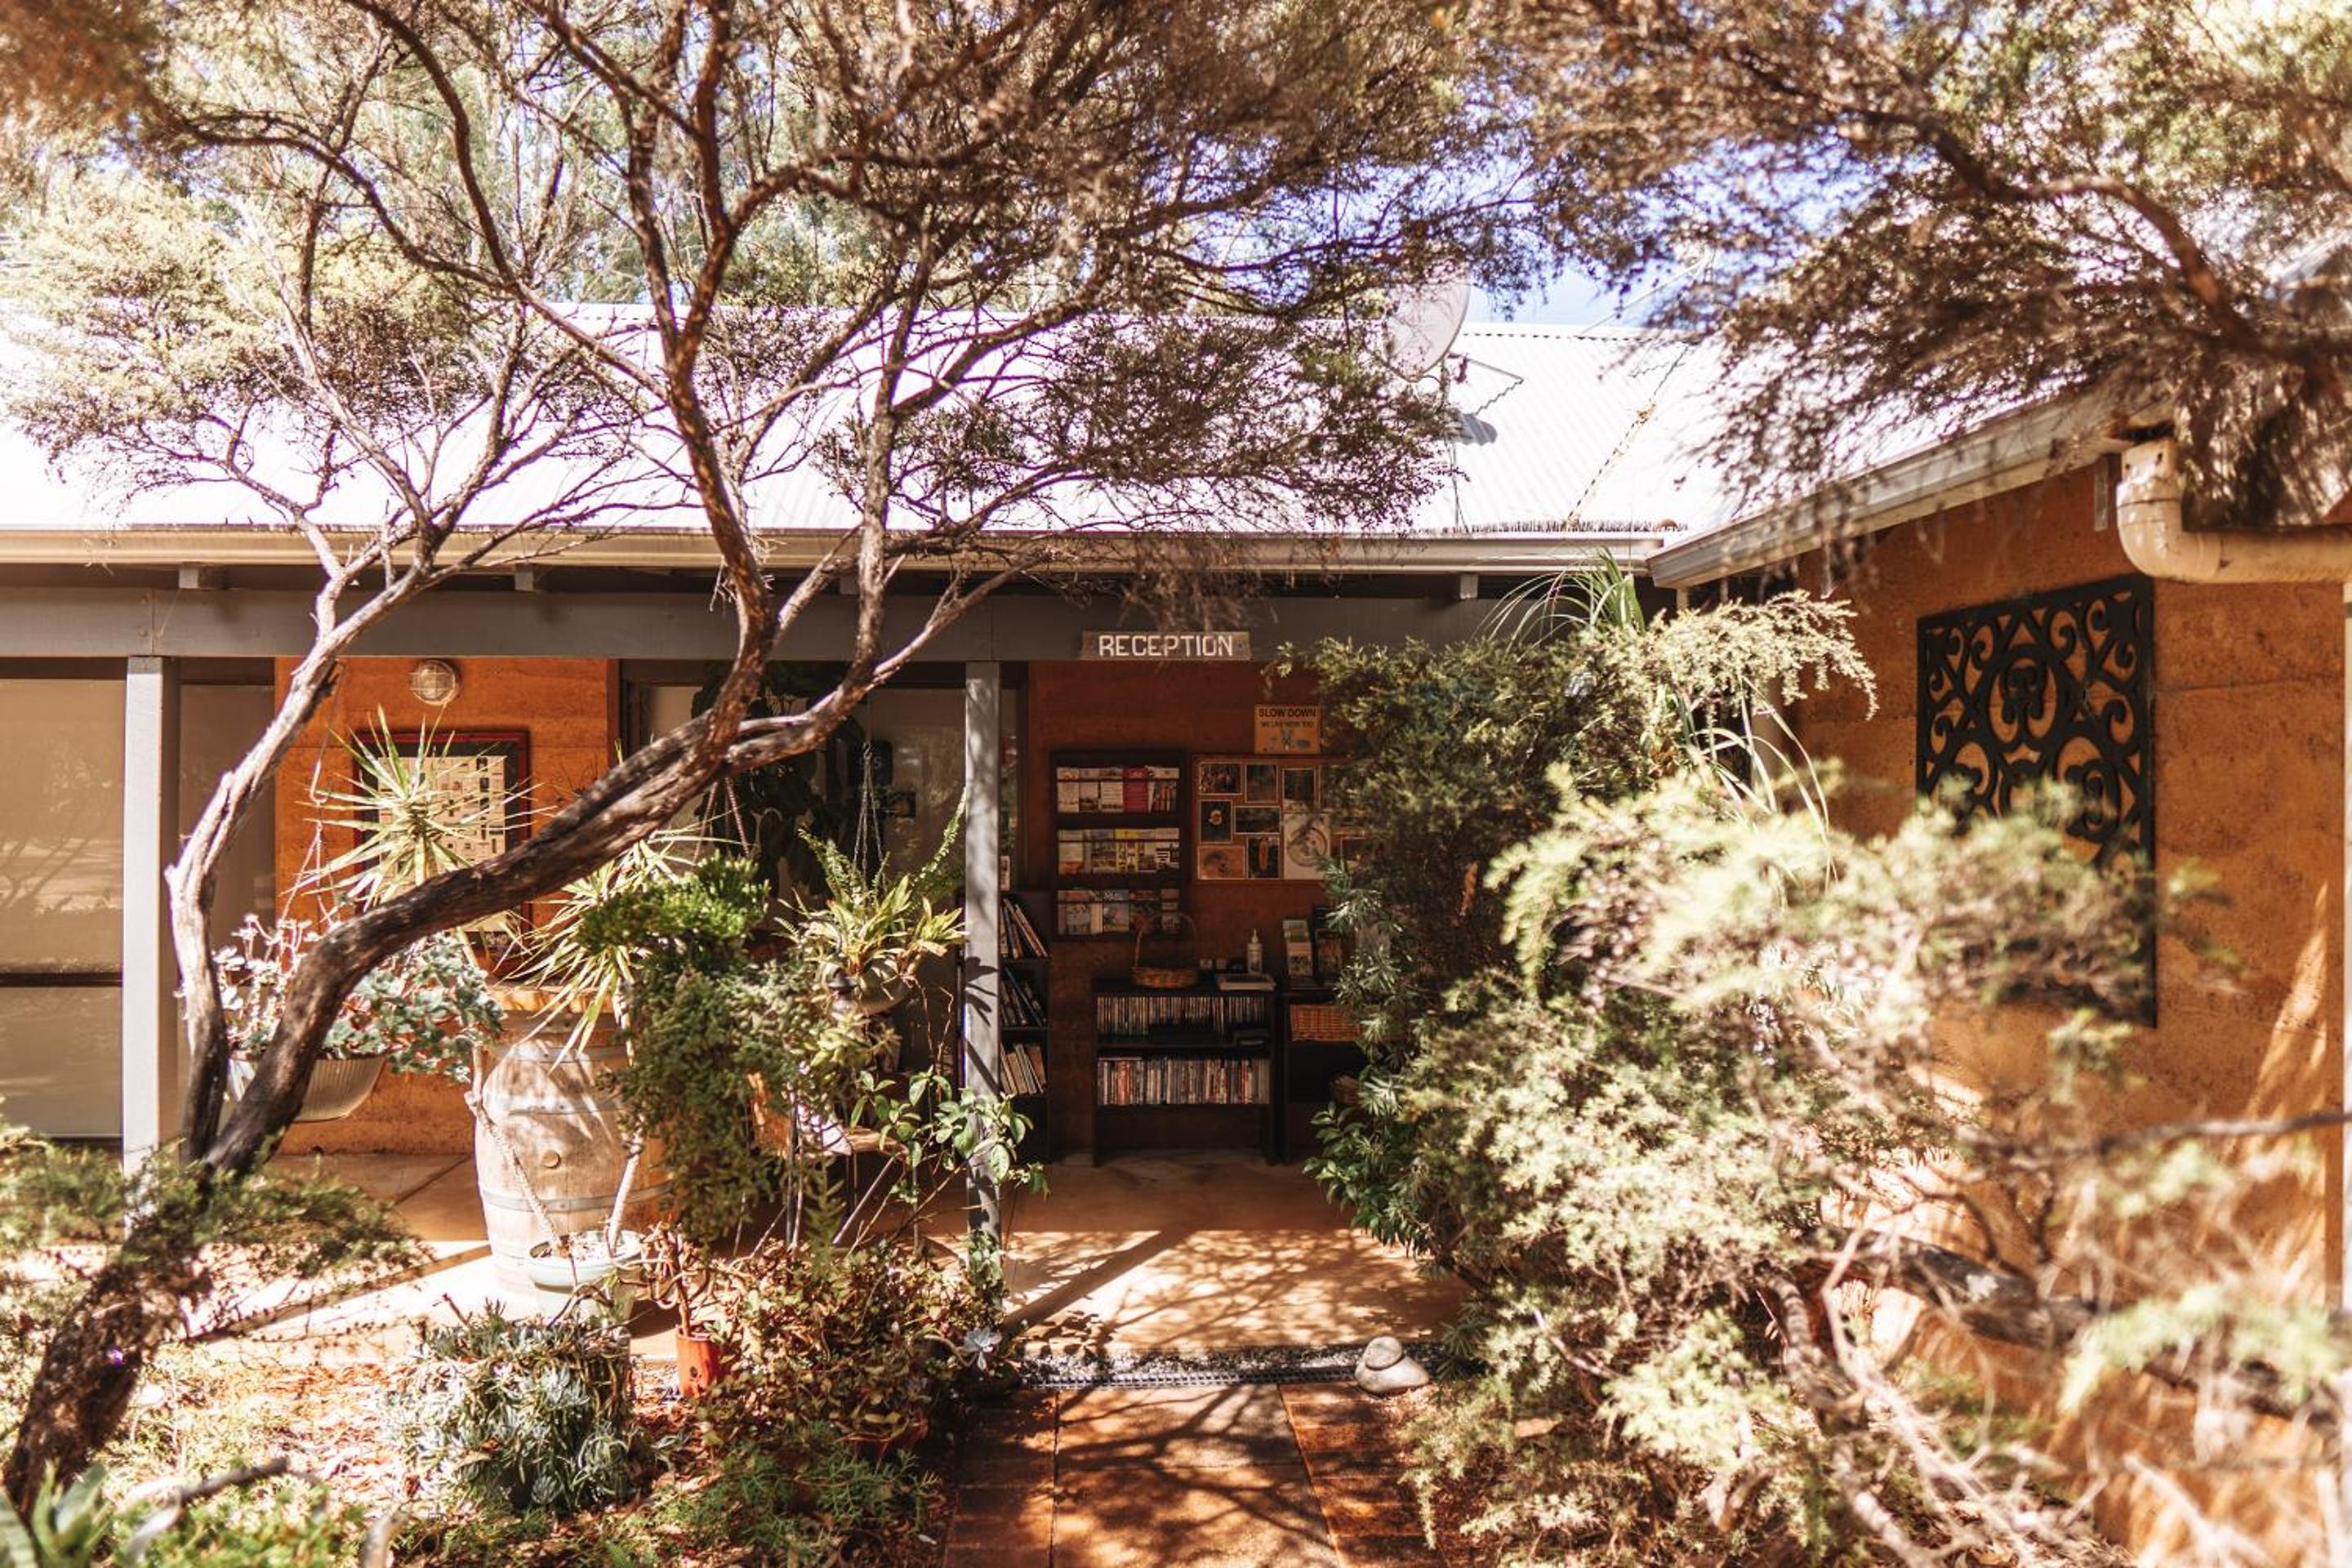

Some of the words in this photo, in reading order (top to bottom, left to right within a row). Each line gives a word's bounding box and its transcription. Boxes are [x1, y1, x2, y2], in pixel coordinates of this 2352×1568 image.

[1099, 635, 1233, 657] RECEPTION
[1258, 708, 1287, 718] SLOW
[1288, 708, 1316, 718] DOWN
